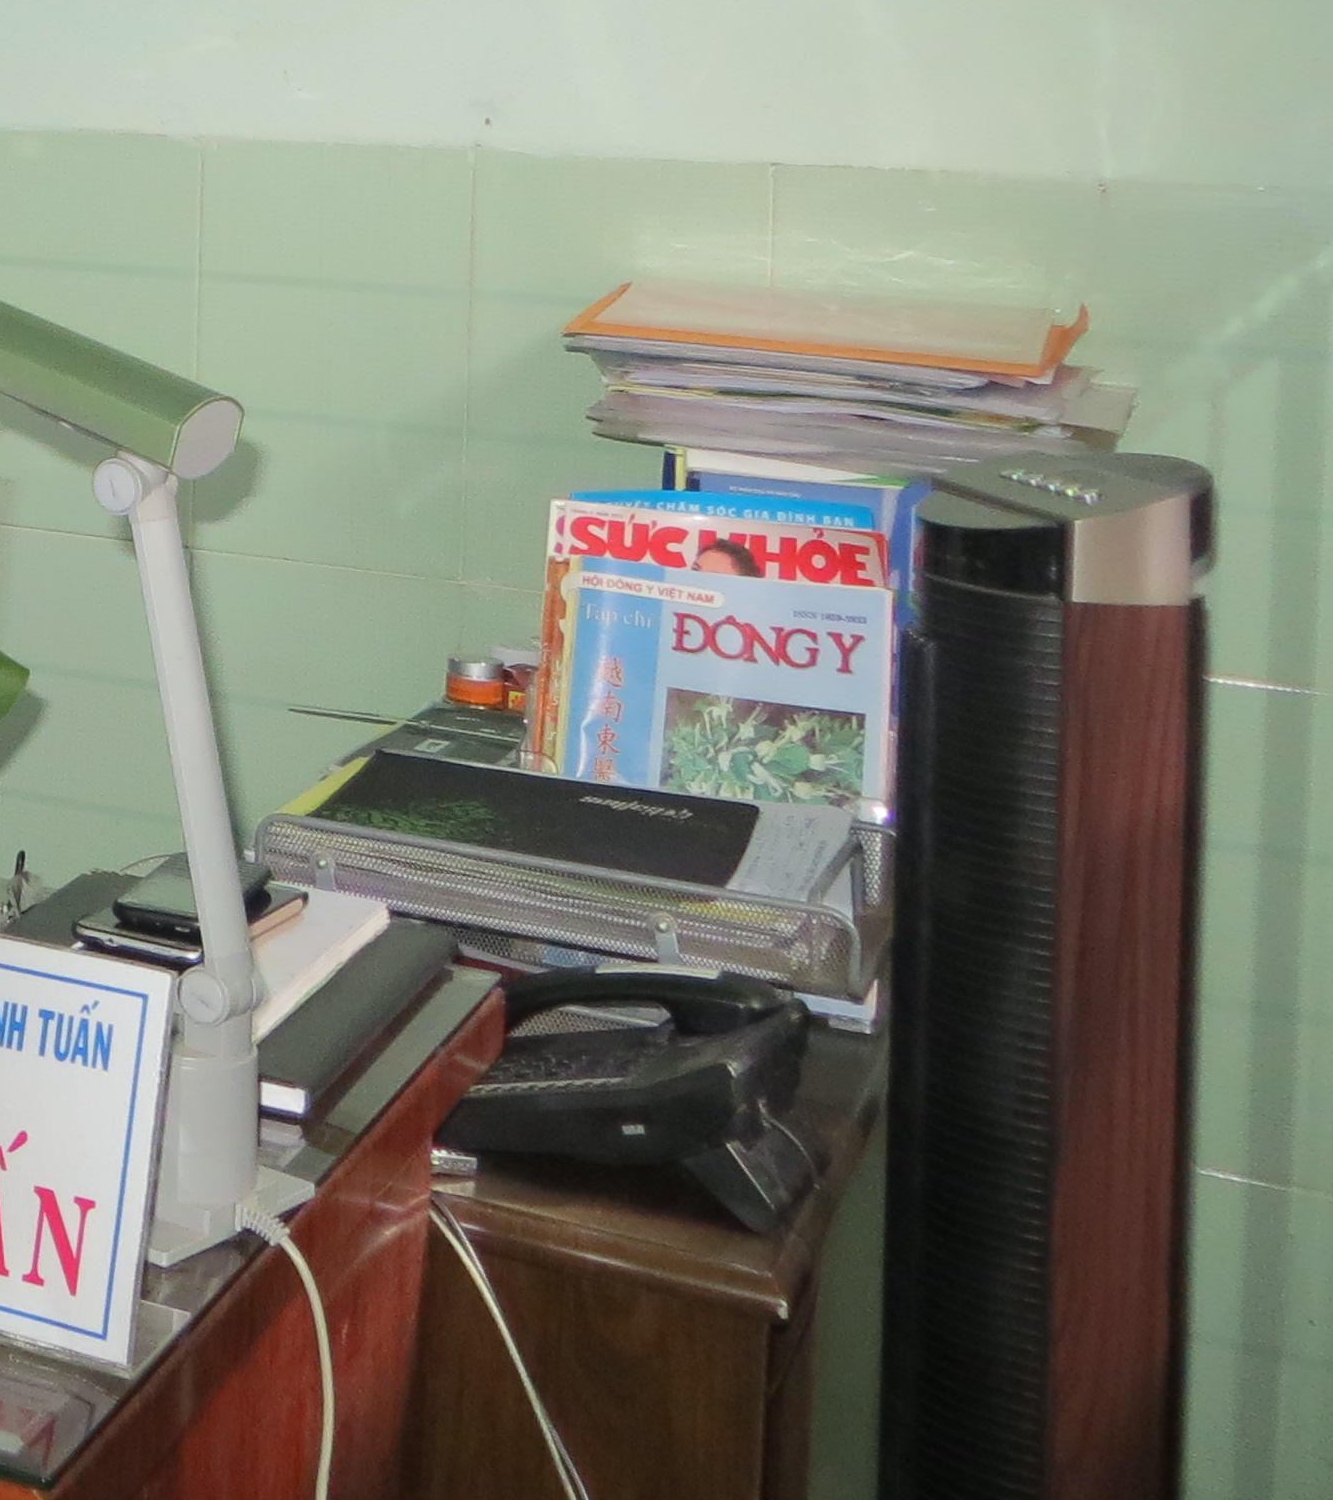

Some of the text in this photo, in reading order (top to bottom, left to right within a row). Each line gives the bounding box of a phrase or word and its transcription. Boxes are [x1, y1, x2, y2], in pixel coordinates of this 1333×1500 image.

[568, 513, 690, 568] SỨC
[743, 509, 770, 520] GIA
[646, 583, 654, 594] Y
[658, 585, 684, 600] VIỆT
[686, 590, 715, 603] NAM
[671, 611, 866, 674] ĐÔNG Y
[38, 1000, 115, 1071] TUẤN
